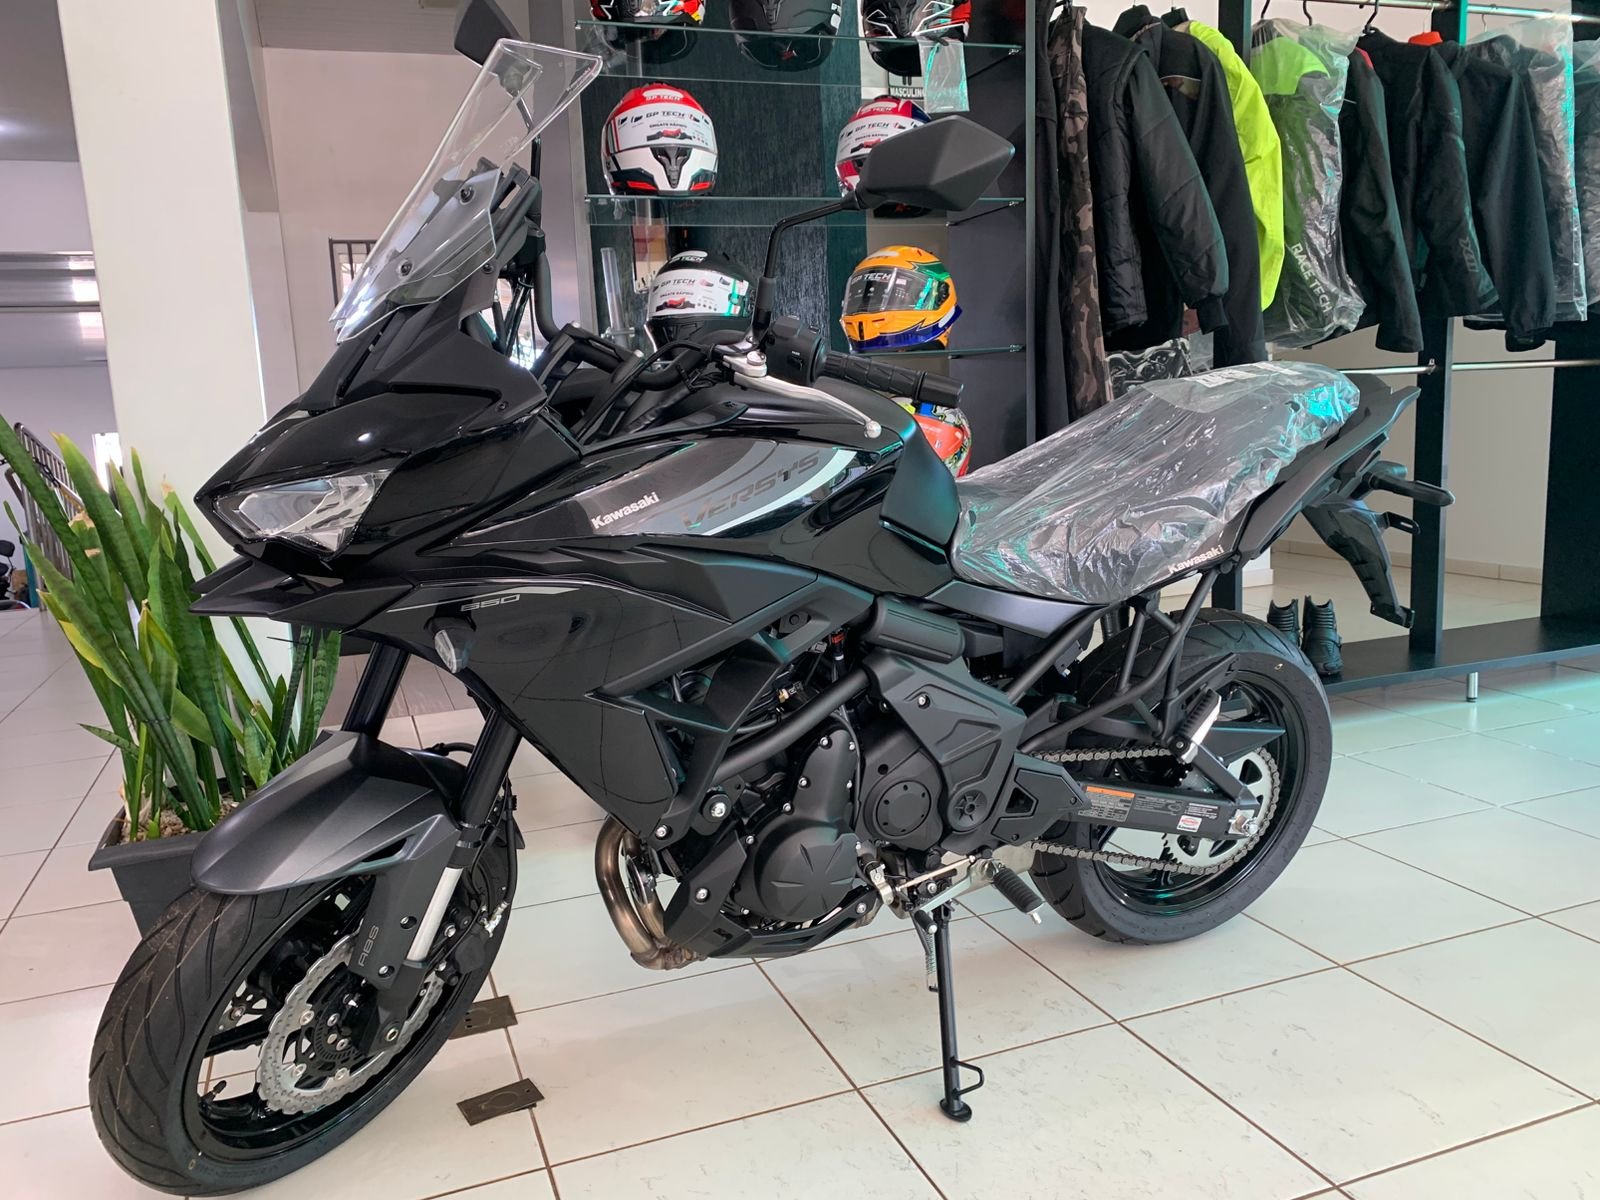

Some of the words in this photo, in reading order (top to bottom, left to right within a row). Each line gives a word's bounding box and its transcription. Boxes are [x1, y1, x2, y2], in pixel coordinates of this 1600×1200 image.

[661, 110, 685, 118] TECH
[864, 272, 892, 281] TECH
[1291, 243, 1316, 280] RACE
[1309, 280, 1333, 313] TECH
[681, 450, 820, 529] VERSYS
[591, 491, 660, 530] Kawasaki
[1168, 544, 1225, 574] Kawasaki
[460, 594, 520, 612] 650
[358, 925, 379, 967] ABS
